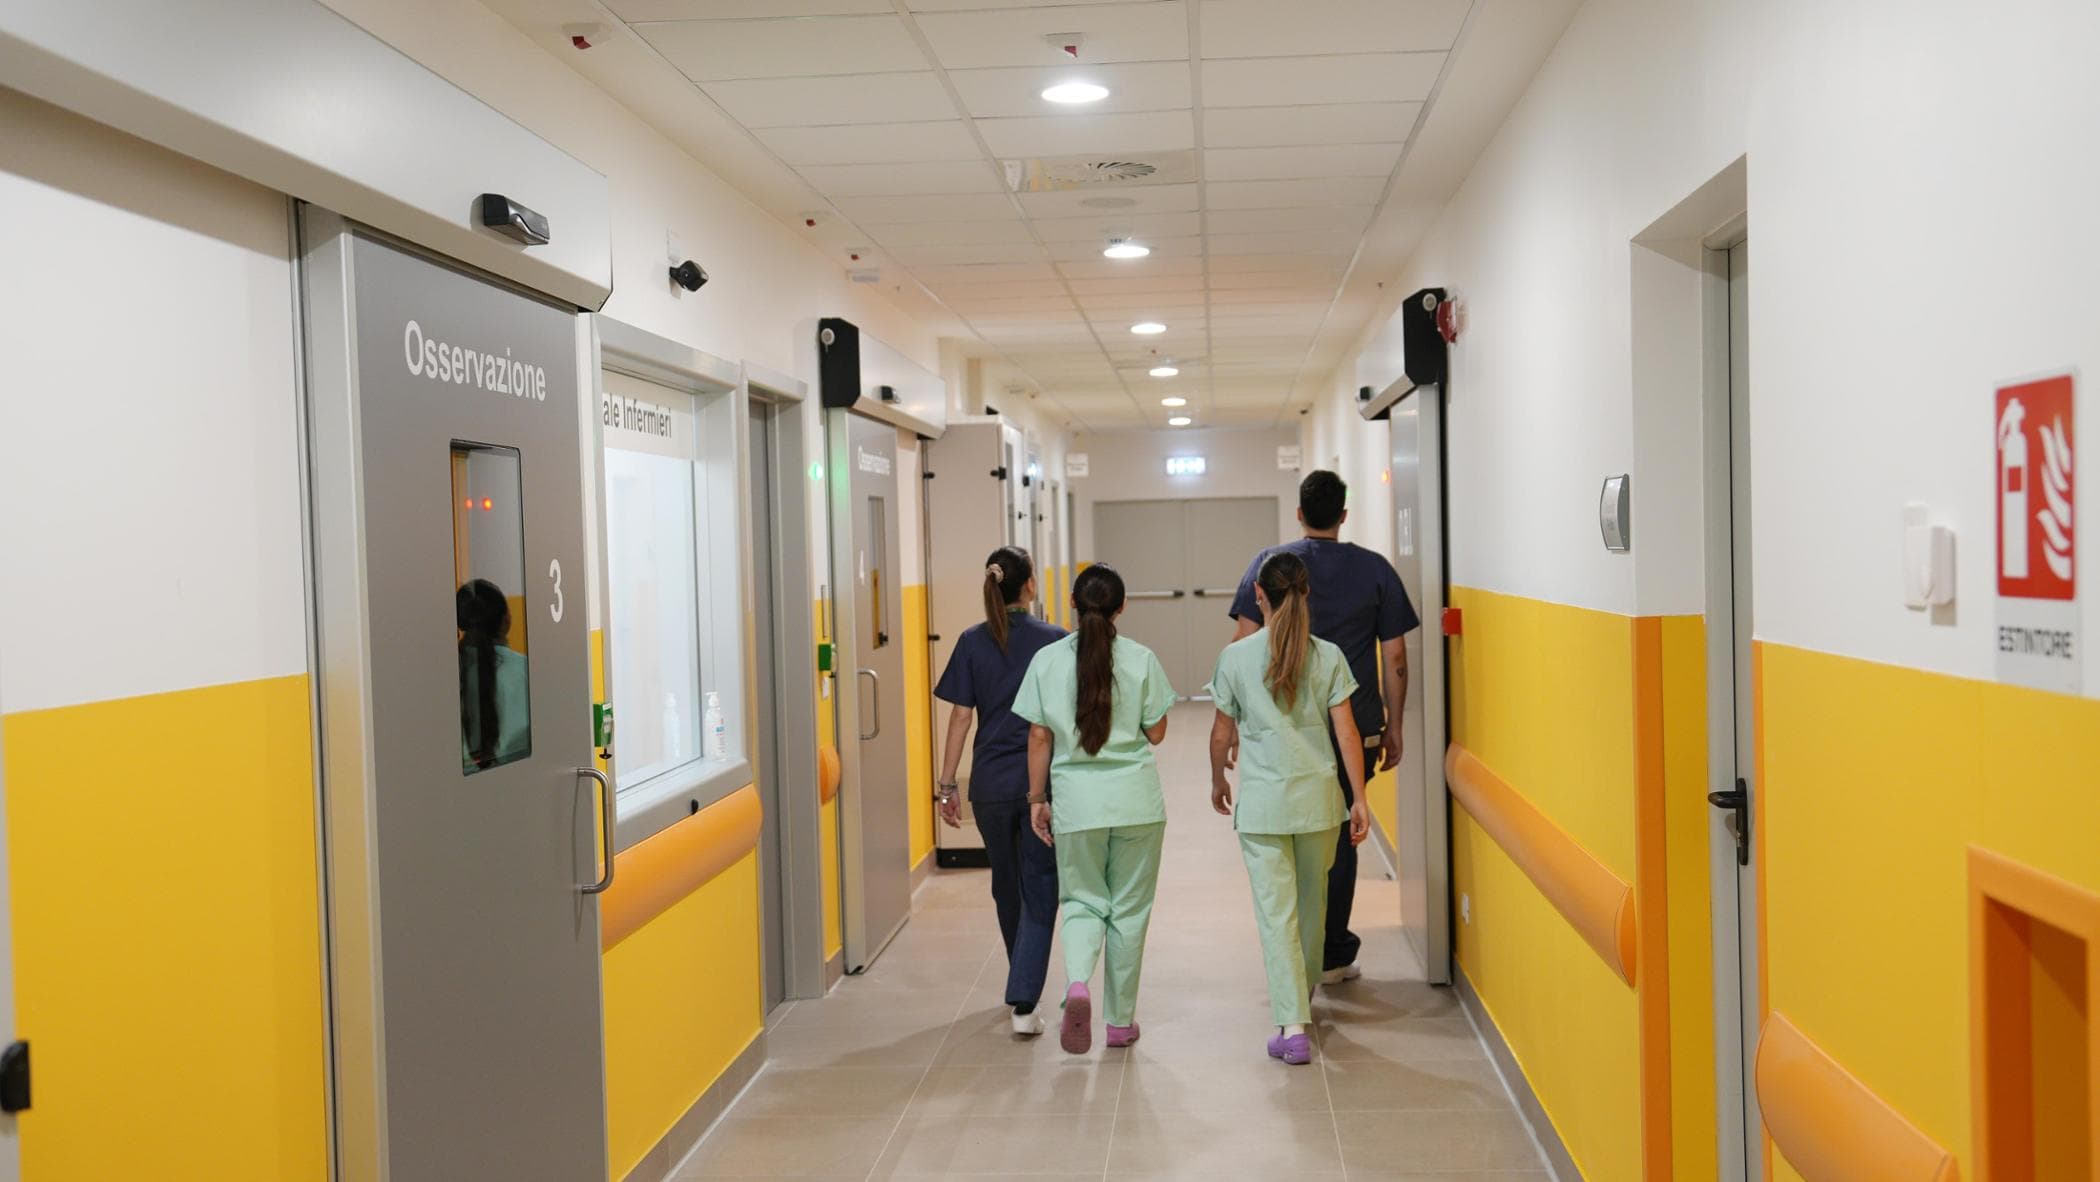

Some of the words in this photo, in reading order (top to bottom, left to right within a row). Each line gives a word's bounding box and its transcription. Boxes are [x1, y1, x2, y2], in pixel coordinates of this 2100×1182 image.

[404, 319, 546, 401] Osservazione
[622, 395, 672, 438] Infermieri
[549, 558, 563, 623] 3
[1999, 626, 2072, 659] ESTINTORE
